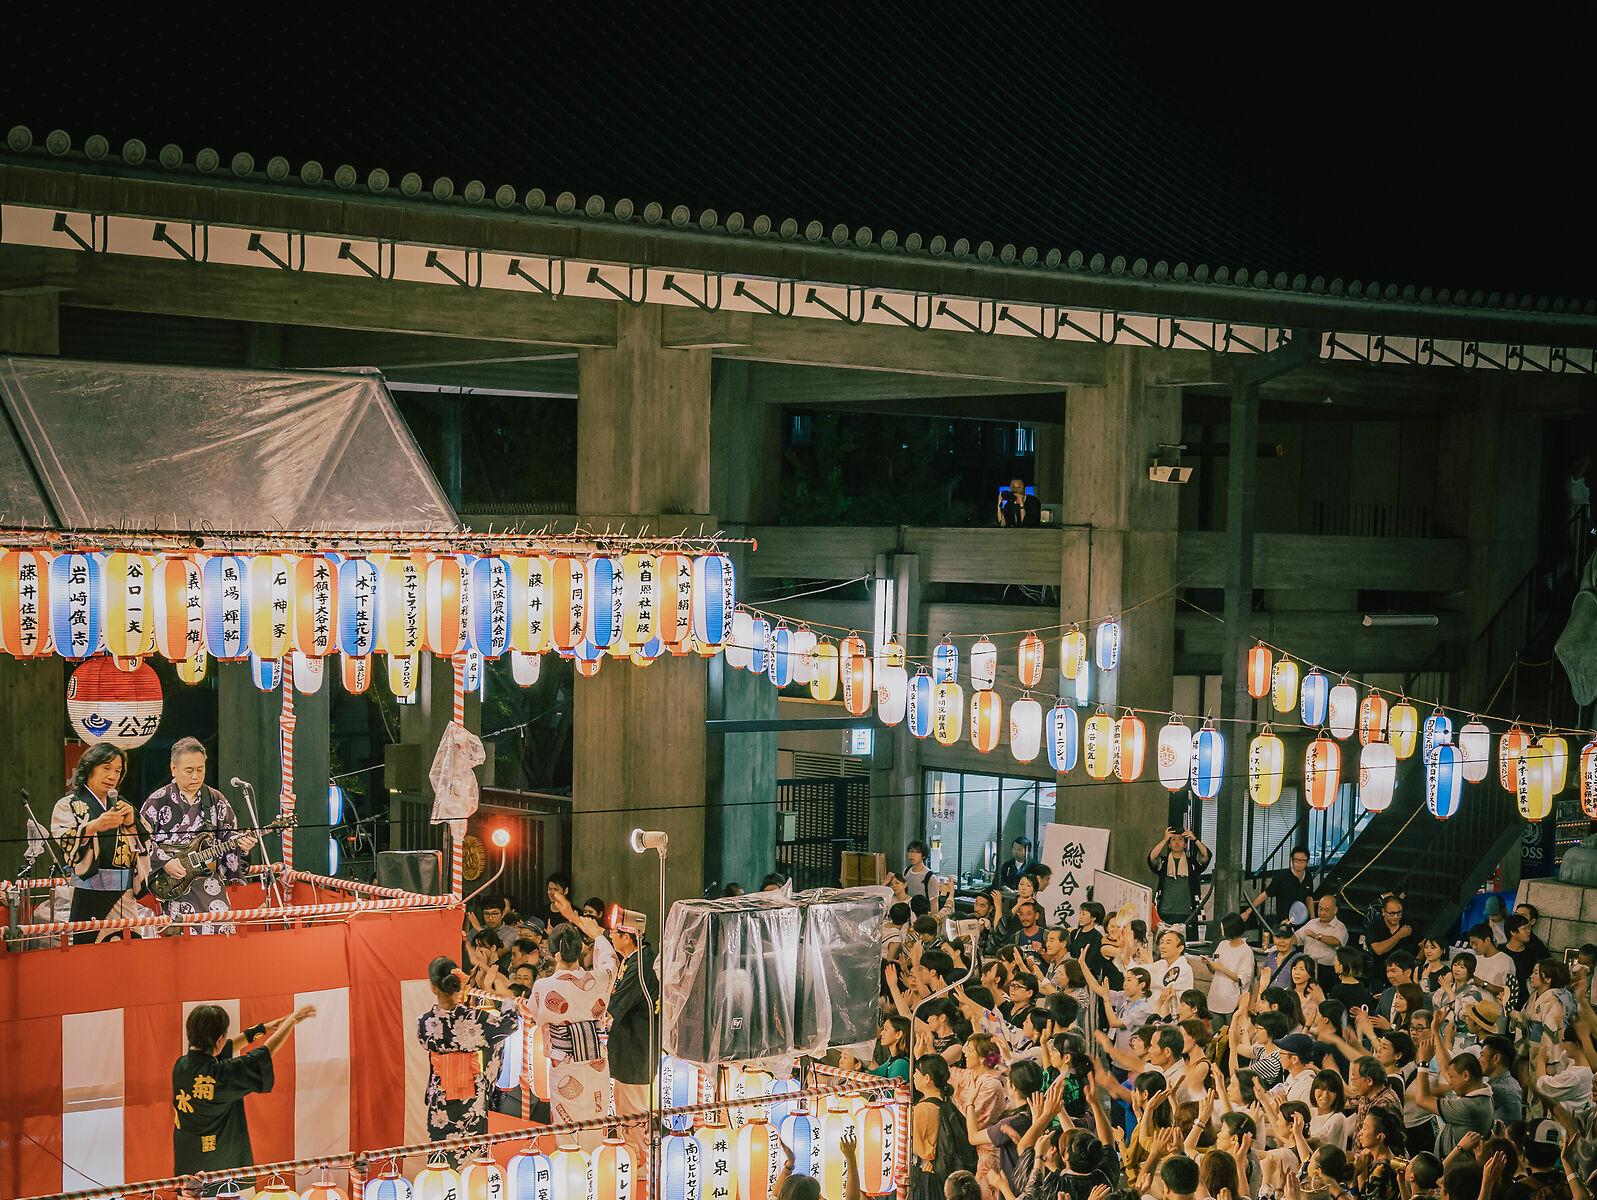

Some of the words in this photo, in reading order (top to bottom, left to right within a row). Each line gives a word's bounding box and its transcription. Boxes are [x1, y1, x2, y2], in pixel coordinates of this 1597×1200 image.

[19, 564, 38, 646] 藤井佐登子
[126, 564, 144, 634] 谷口一夫
[272, 571, 288, 638] 石神家
[353, 576, 370, 647] 木下生花店
[528, 573, 544, 635] 藤井家
[676, 564, 691, 627] 大野絹江
[118, 715, 160, 737] 公益
[1521, 847, 1543, 859] OSS
[174, 1074, 217, 1130] 菊水
[883, 1123, 894, 1177] セレスポ
